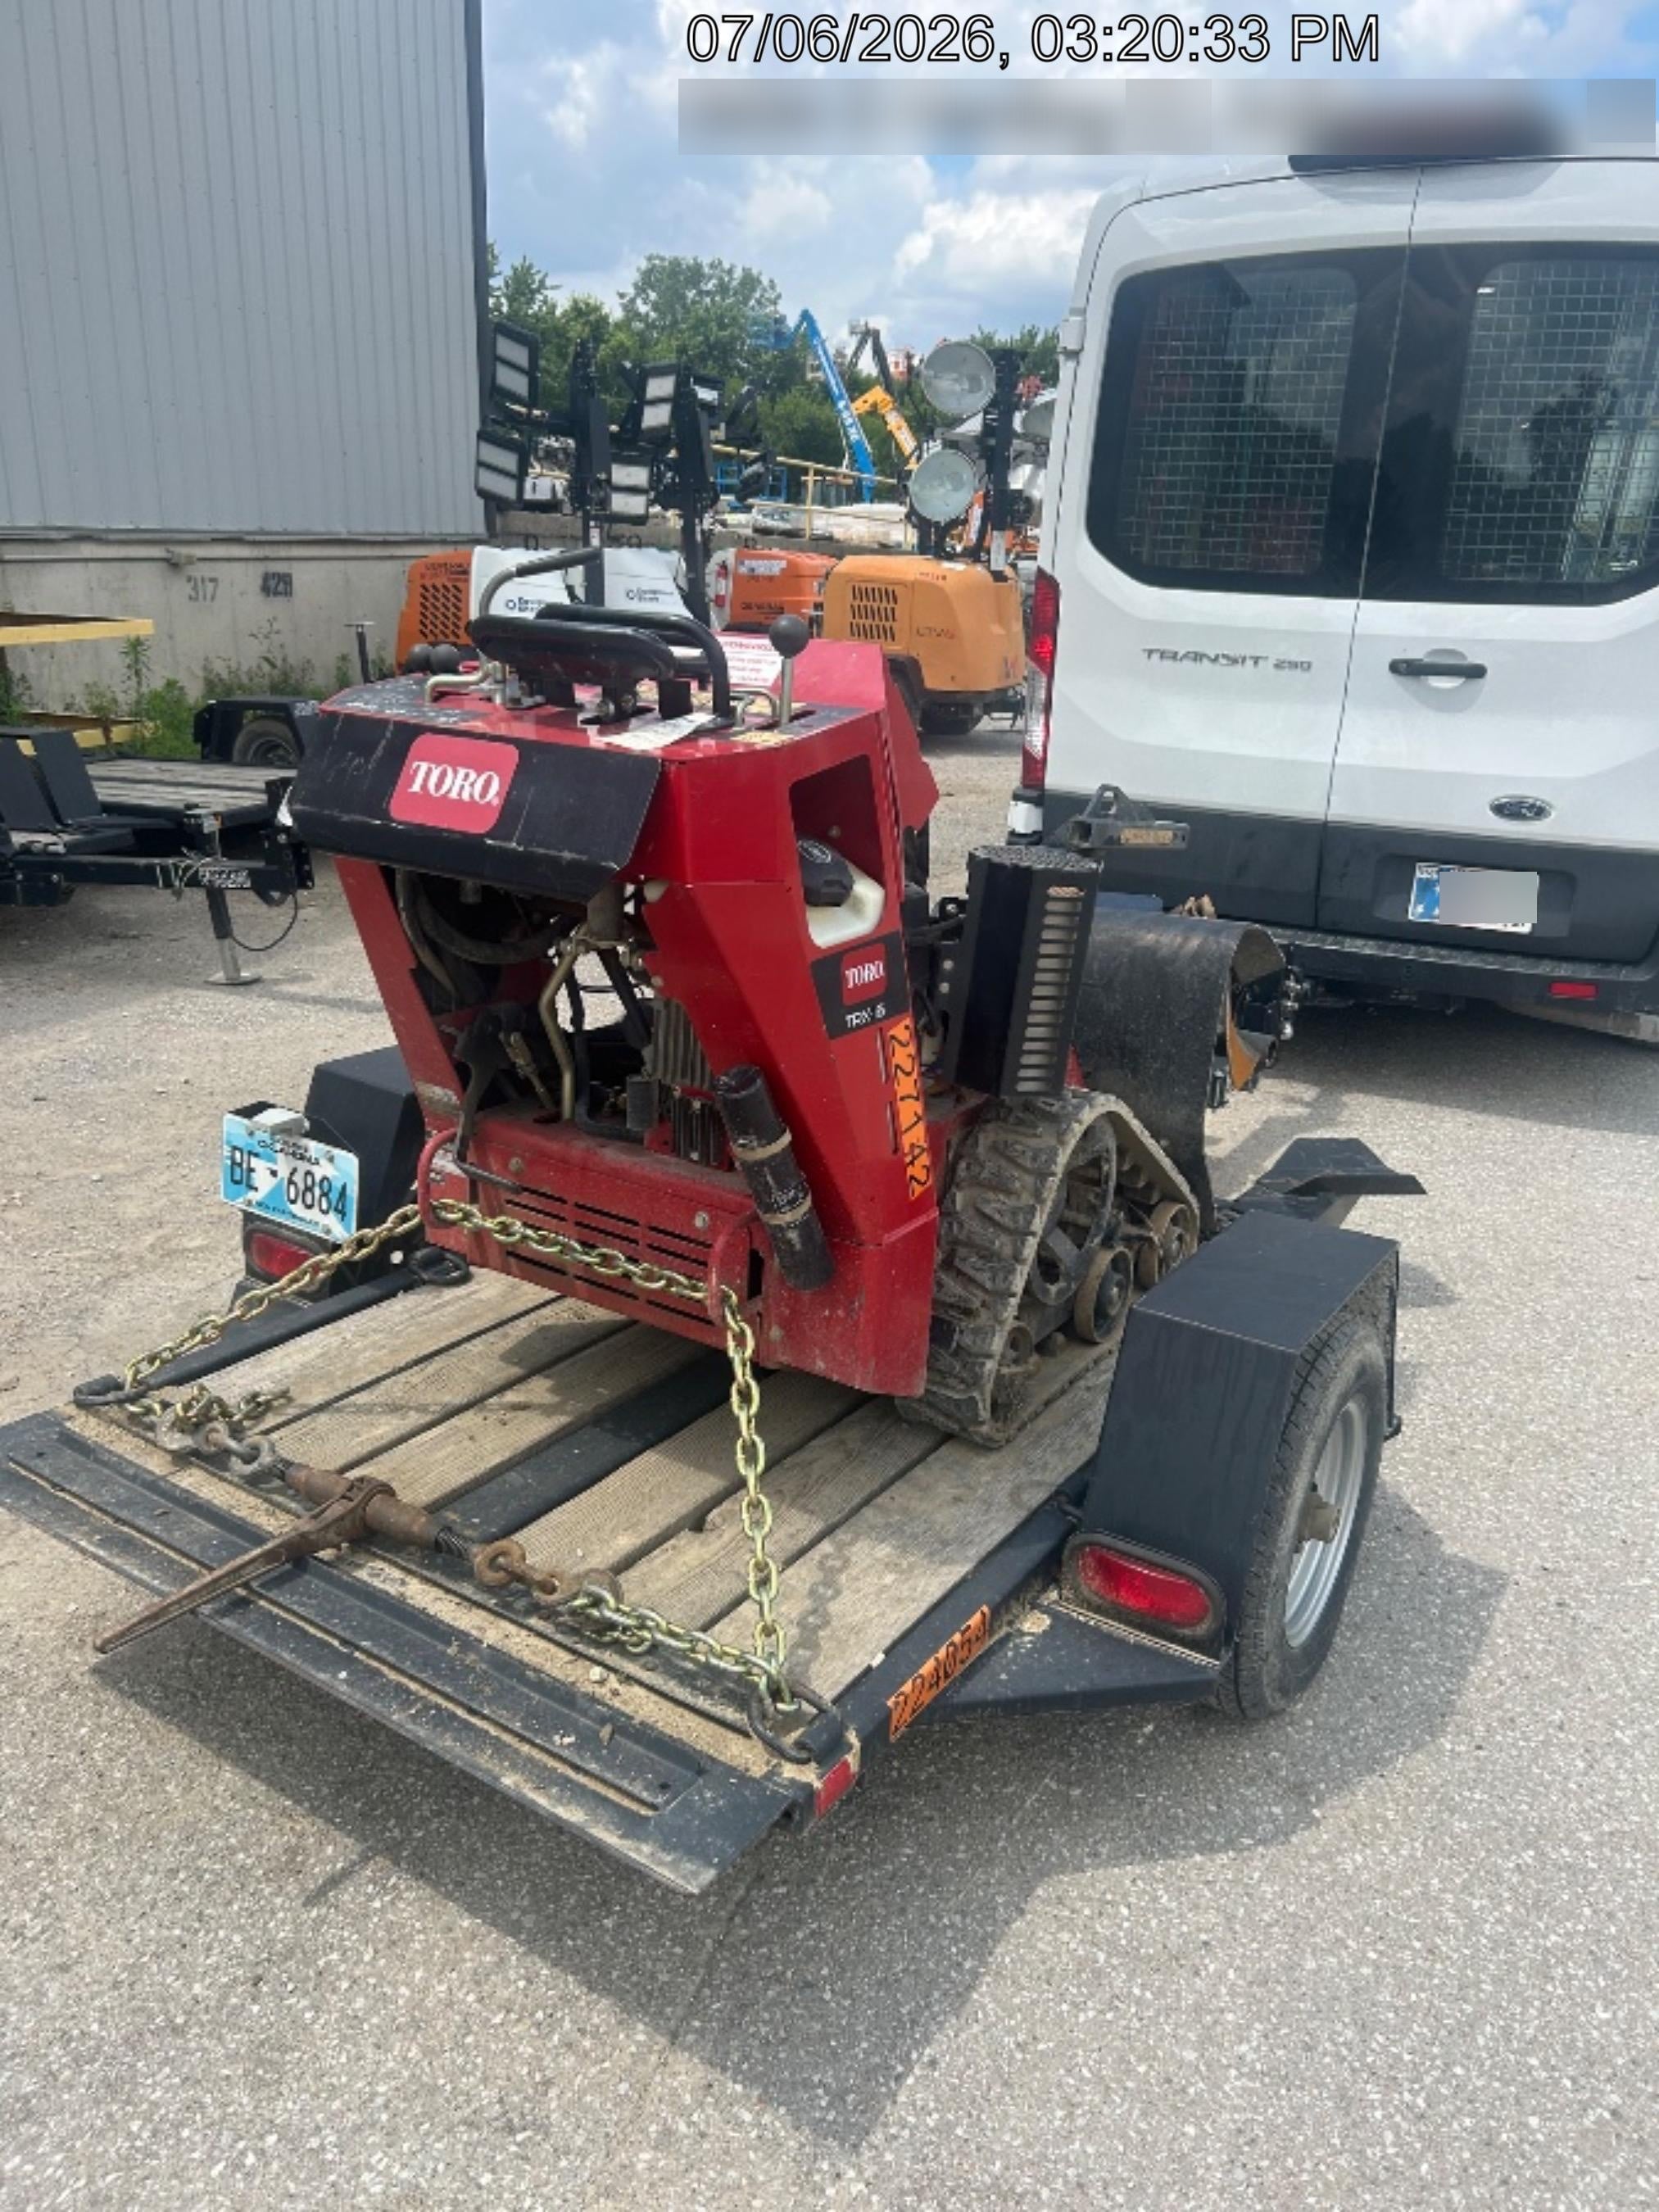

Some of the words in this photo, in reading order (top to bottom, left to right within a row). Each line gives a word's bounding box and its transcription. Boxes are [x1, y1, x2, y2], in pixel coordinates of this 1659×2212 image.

[1141, 648, 1269, 668] TRANSIT
[407, 760, 500, 805] TORO
[230, 1145, 261, 1193] BE
[287, 1166, 348, 1222] 6884
